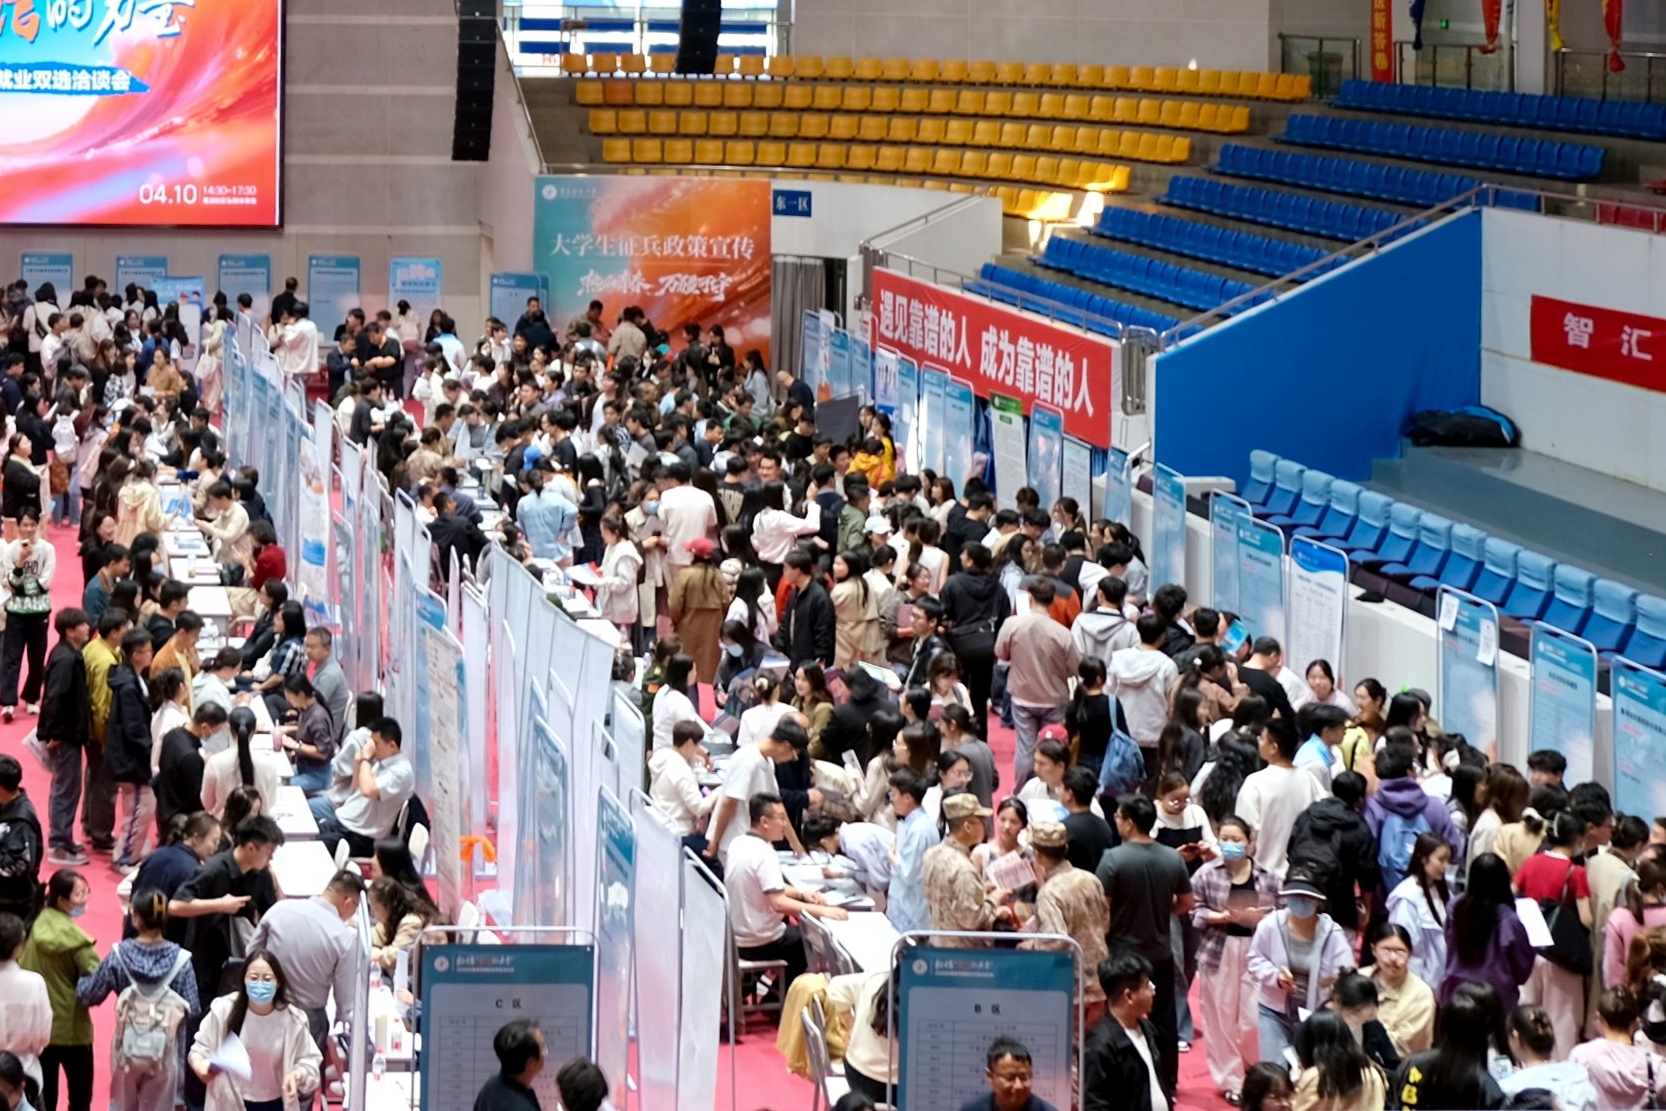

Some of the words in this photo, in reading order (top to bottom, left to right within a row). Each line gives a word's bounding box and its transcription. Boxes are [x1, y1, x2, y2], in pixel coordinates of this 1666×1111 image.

[139, 183, 198, 205] 04.10
[775, 193, 809, 211] 东一区
[549, 233, 755, 261] 大学生征兵政策宣传
[1563, 312, 1653, 361] 智汇
[879, 290, 972, 370] 遇见靠谱的人
[980, 325, 1095, 417] 成为靠谱的人
